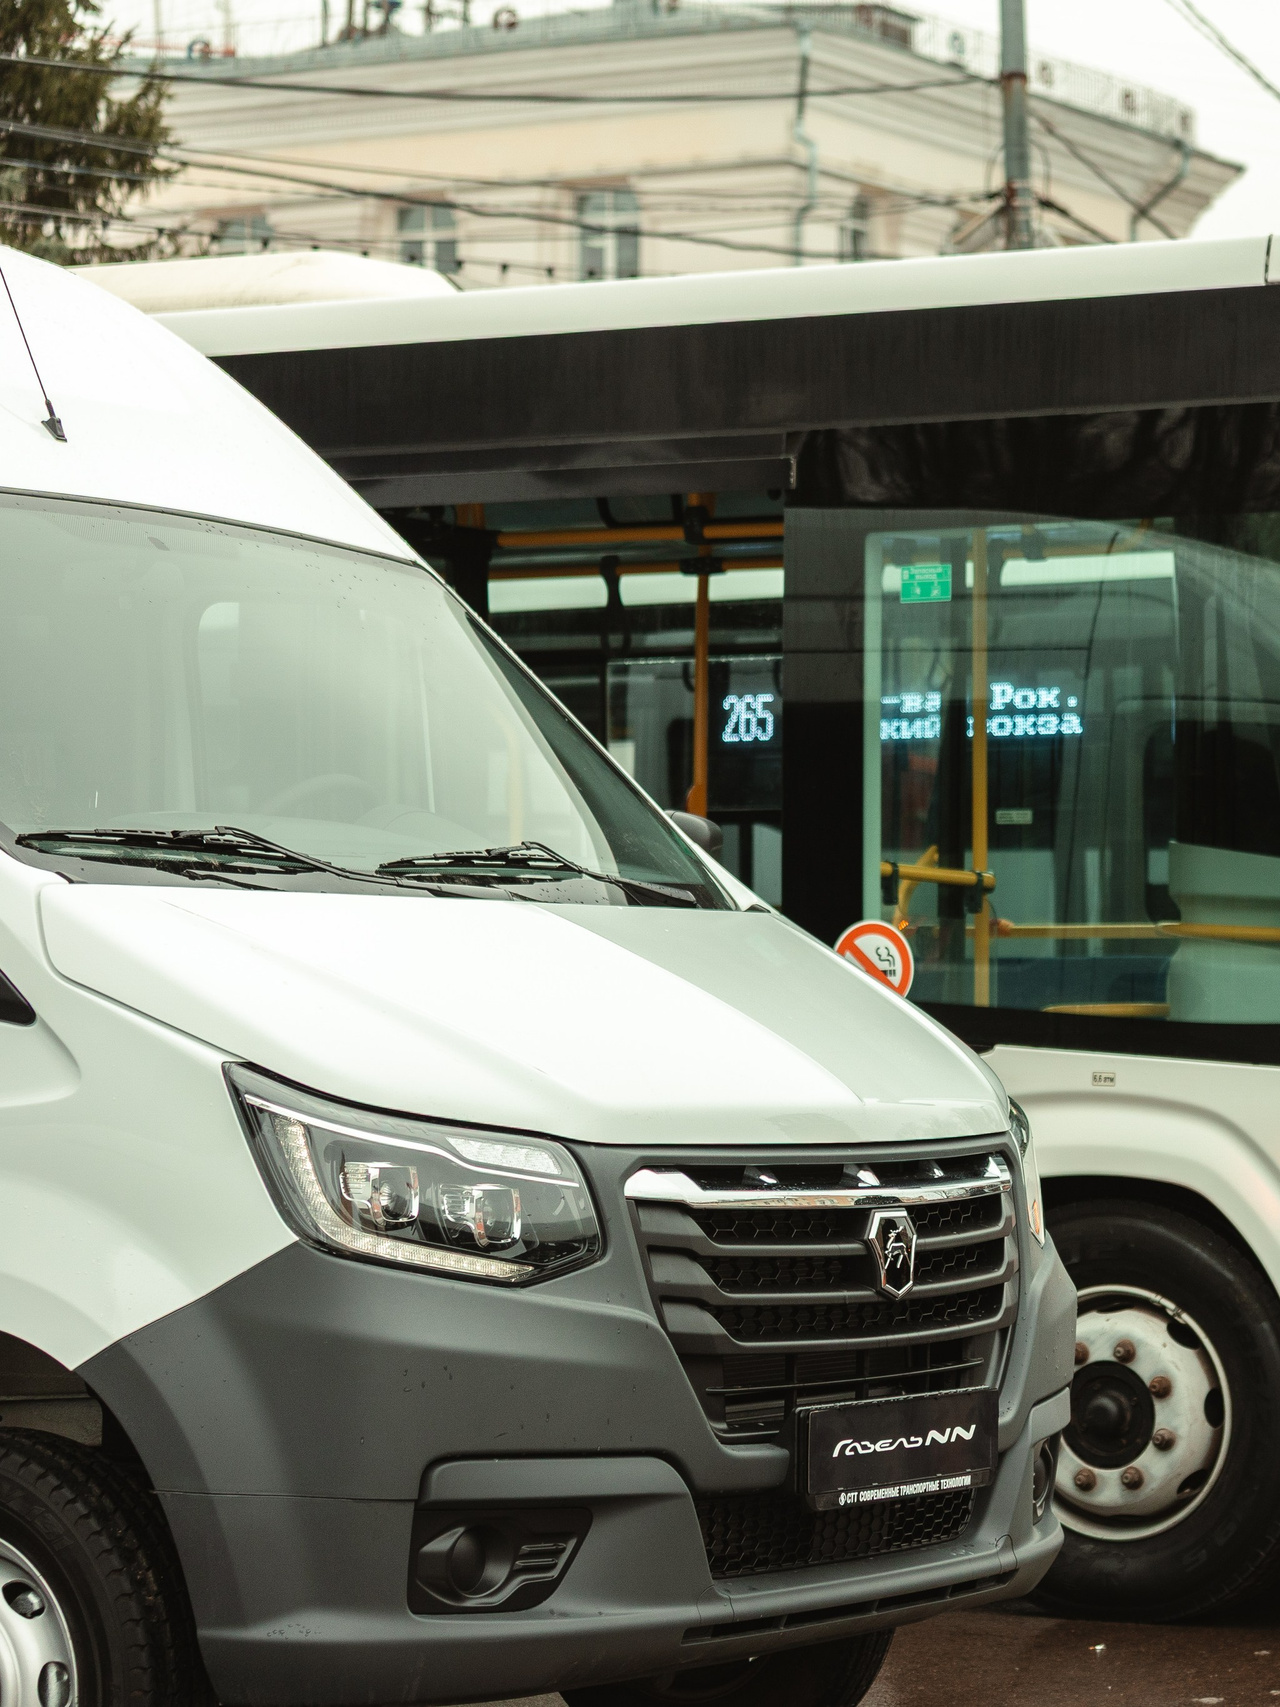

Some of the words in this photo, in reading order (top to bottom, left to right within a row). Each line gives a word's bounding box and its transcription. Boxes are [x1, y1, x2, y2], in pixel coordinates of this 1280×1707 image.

[990, 682, 1078, 710] Рок.
[722, 693, 775, 743] 265
[847, 1492, 859, 1504] СТТ
[859, 1486, 900, 1502] СОВРЕМЕННЫЕ
[900, 1480, 940, 1496] ТРАНСПОРТНЫЕ
[940, 1475, 972, 1490] ТЕХНОЛОГИИ
